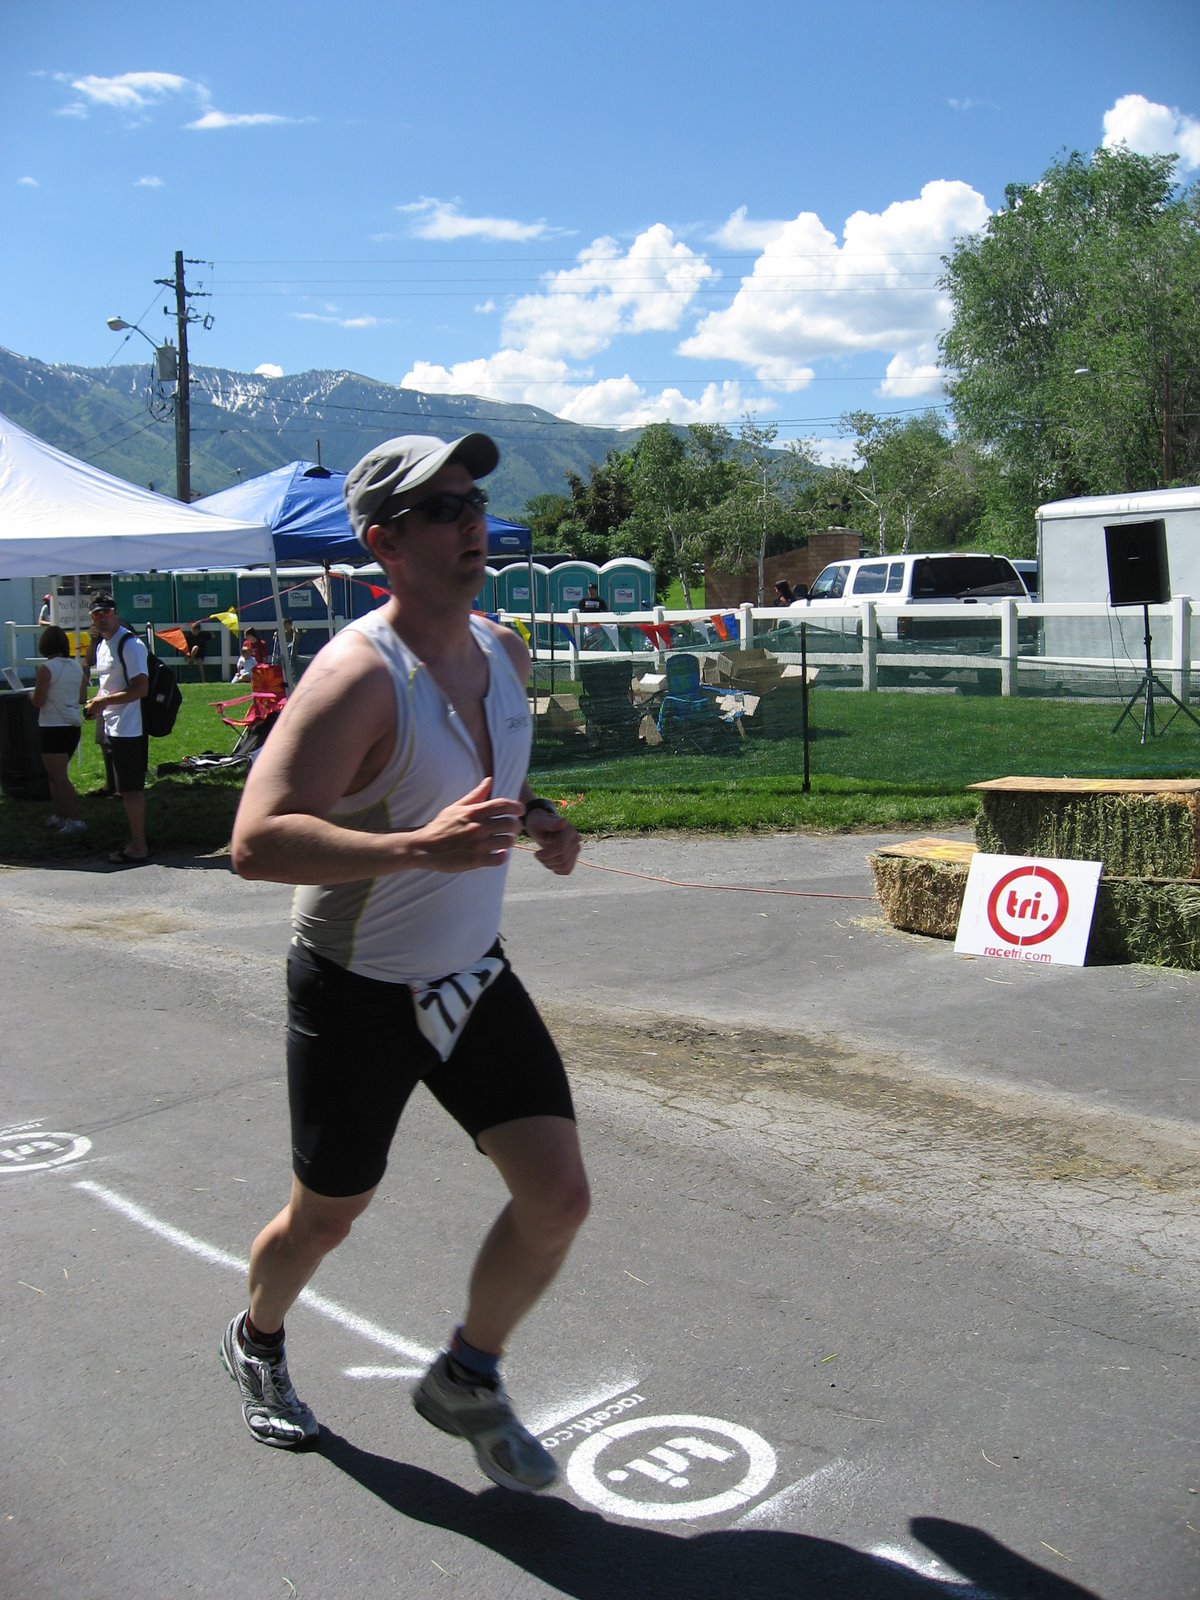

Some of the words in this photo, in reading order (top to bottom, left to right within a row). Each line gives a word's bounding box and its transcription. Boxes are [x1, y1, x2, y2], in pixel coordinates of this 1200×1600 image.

[1007, 890, 1049, 921] tri.
[984, 947, 1052, 962] racetri.com
[541, 1393, 647, 1451] racetri.co
[607, 1436, 736, 1488] tri.
